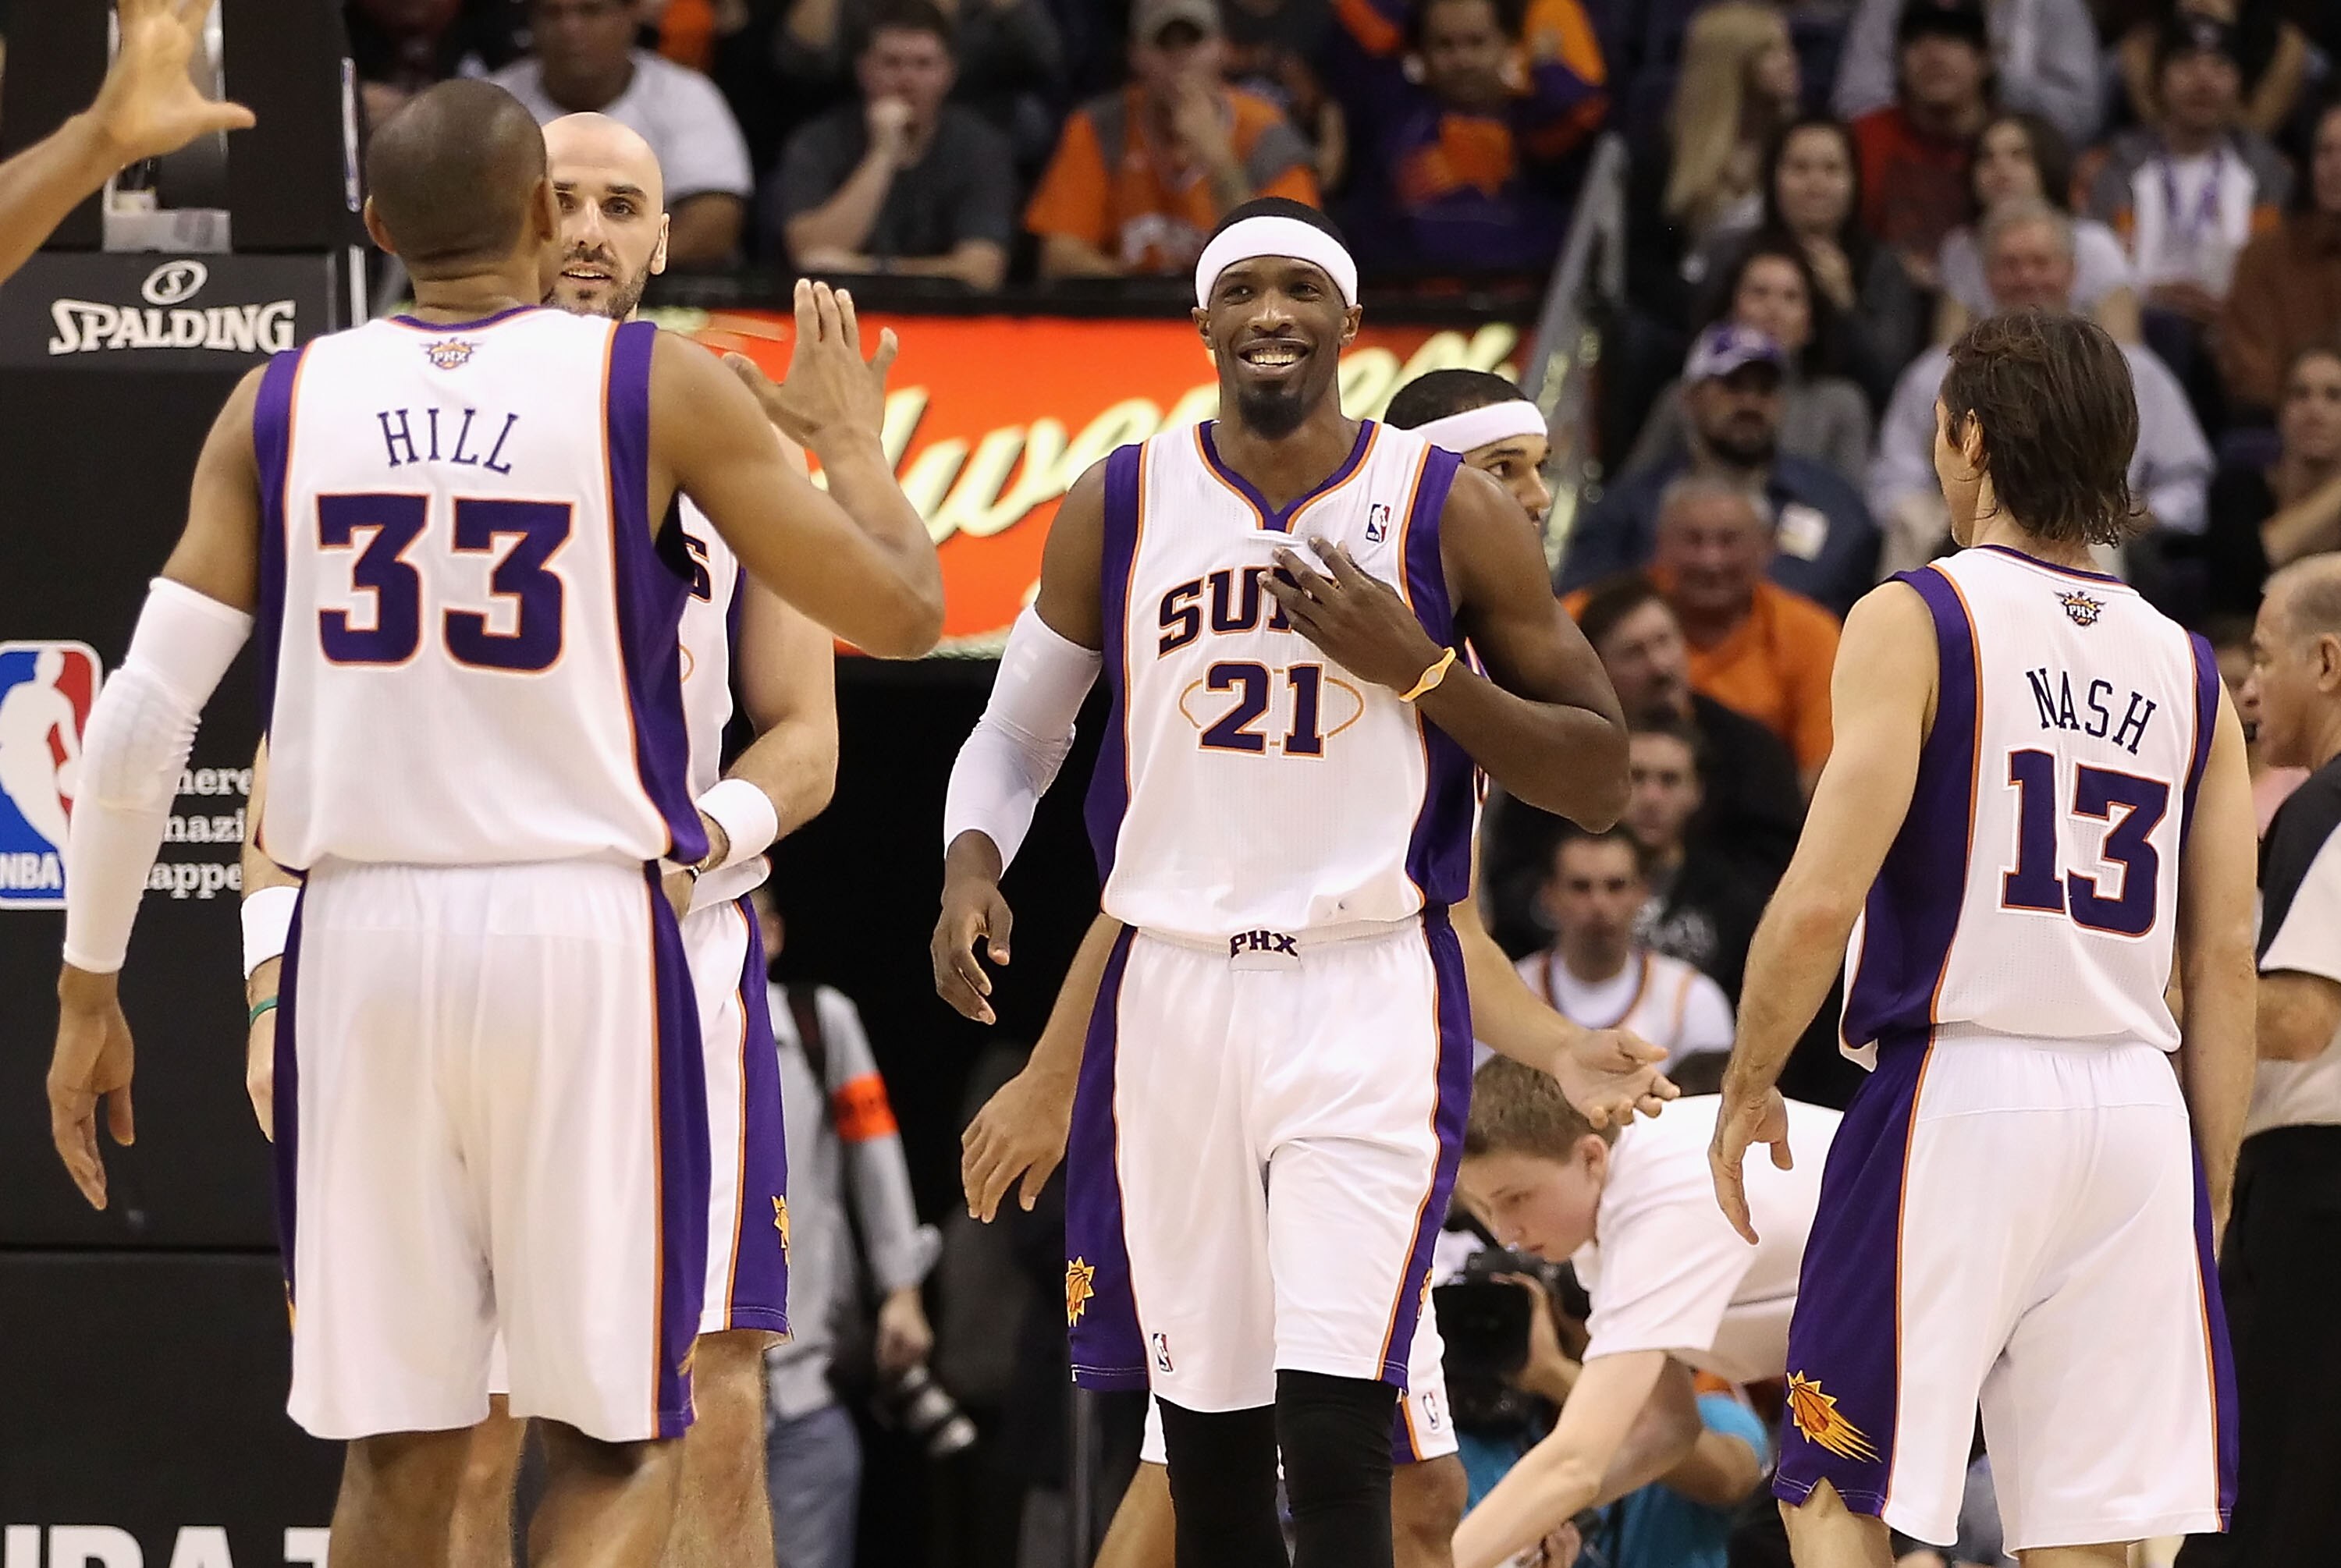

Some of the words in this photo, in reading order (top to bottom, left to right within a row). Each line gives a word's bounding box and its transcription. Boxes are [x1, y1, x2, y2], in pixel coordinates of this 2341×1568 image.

[48, 298, 297, 356] SPALDING
[376, 407, 520, 475] HILL
[314, 492, 576, 676] 33
[2067, 604, 2097, 621] PHX
[1197, 659, 1325, 758] 21
[2026, 668, 2157, 756] NASH
[176, 768, 254, 796] here
[0, 852, 63, 890] NBA
[1999, 747, 2172, 938] 13
[147, 862, 242, 899] appe
[1229, 929, 1298, 959] PHX
